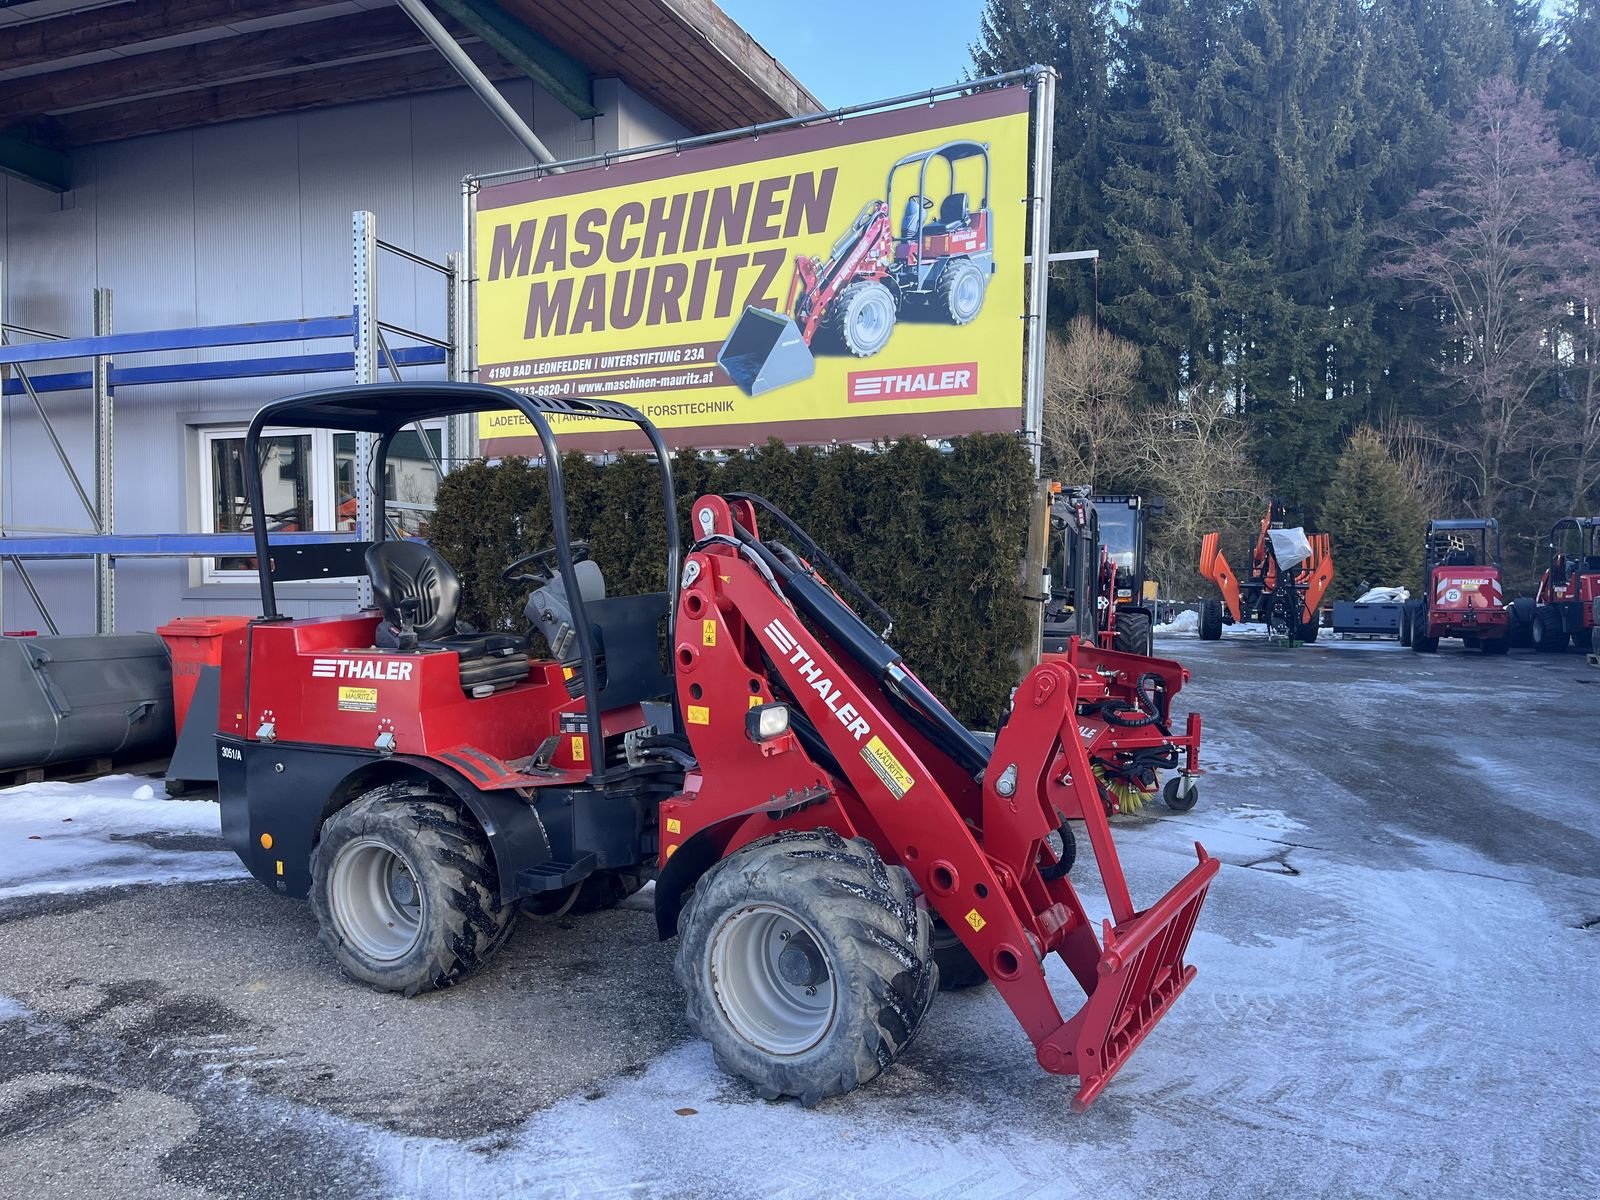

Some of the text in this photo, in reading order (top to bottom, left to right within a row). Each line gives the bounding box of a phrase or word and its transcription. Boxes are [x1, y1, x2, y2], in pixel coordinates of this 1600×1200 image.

[488, 167, 839, 281] MASCHINEN
[524, 248, 787, 340] MAURITZ
[489, 367, 511, 379] 4190
[513, 365, 531, 377] BAD
[533, 359, 592, 375] LEONFELDEN
[600, 350, 681, 368] UNTERSTIFTUNG
[684, 347, 705, 361] 23A
[510, 382, 570, 397] 7213-6820-0
[578, 370, 714, 393] www.maschinen-mauritz.at
[882, 370, 971, 394] THALER
[647, 401, 735, 417] FORSTTECHNIK
[1448, 591, 1458, 600] 25
[337, 660, 413, 681] THALER
[789, 644, 871, 741] THALER
[221, 746, 242, 761] 3051/A
[874, 748, 904, 783] MAURITZ
